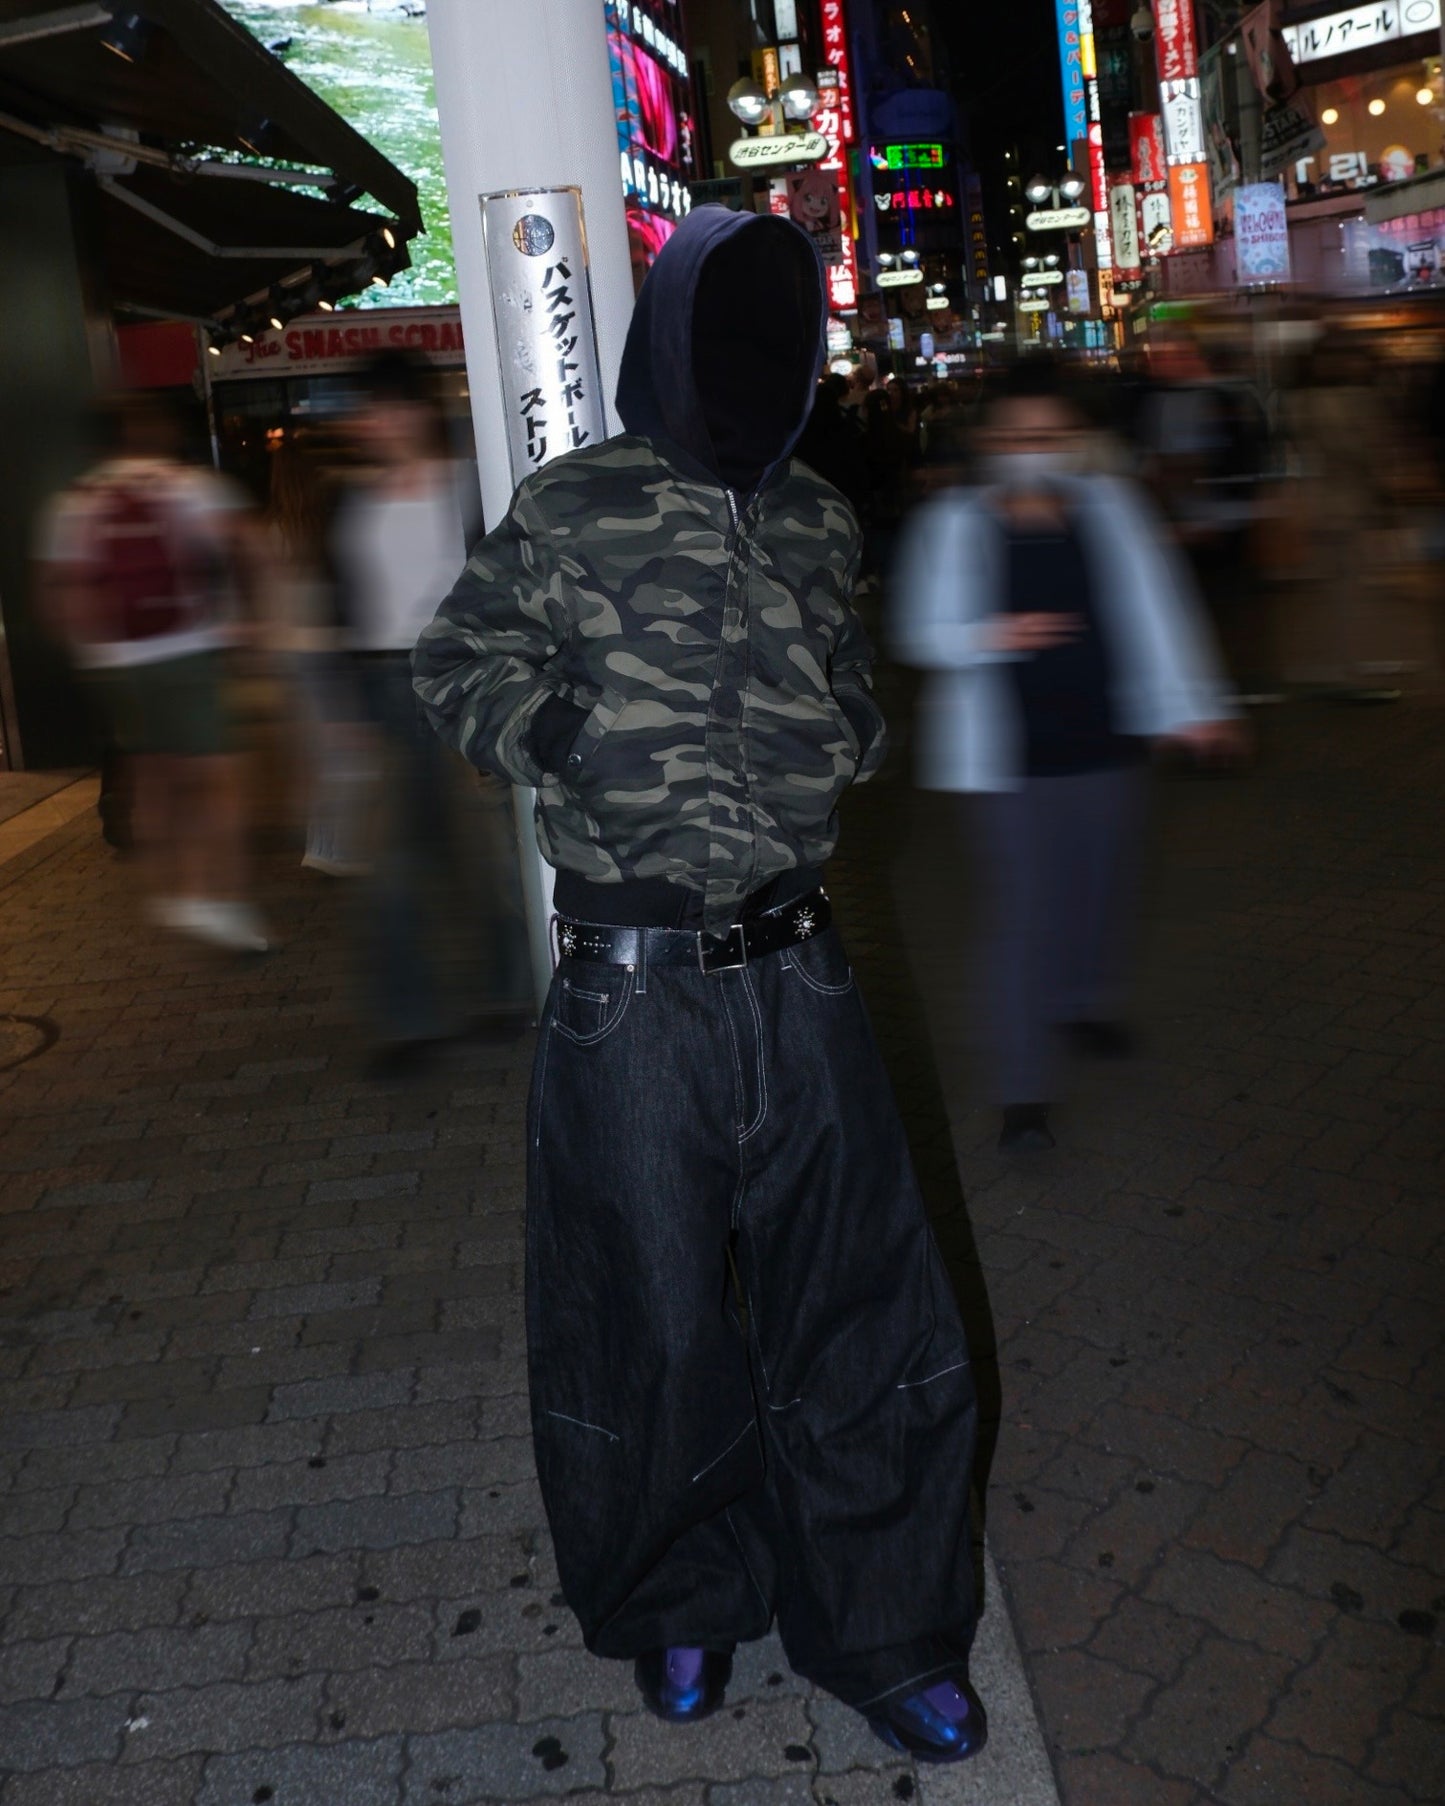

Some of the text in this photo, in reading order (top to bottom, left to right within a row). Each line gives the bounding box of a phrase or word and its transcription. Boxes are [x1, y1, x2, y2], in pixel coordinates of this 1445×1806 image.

[1303, 9, 1394, 52] ルノアール
[237, 333, 281, 363] The
[285, 326, 380, 360] SMASH
[520, 387, 547, 471] ストリ
